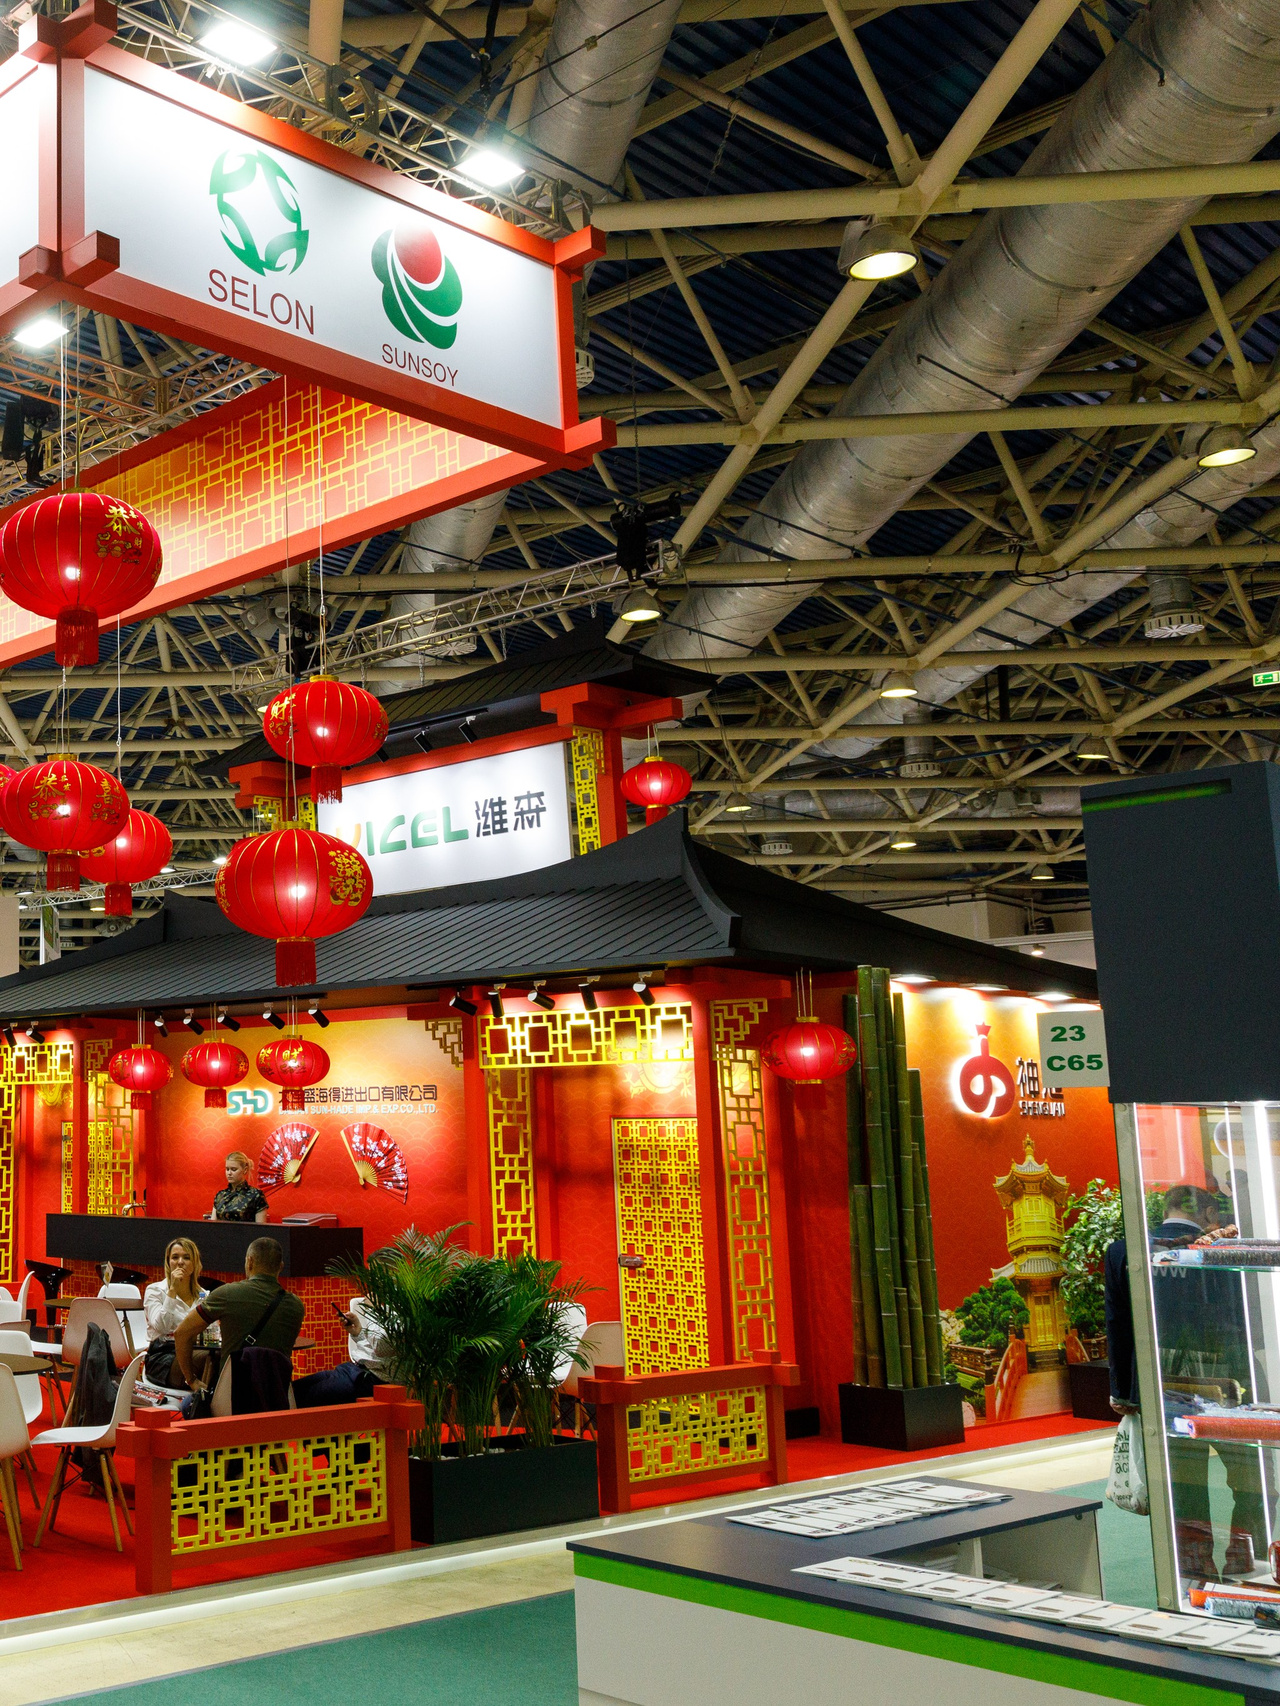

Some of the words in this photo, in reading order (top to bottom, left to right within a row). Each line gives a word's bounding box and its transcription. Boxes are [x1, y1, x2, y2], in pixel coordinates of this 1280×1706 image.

[208, 269, 315, 335] SELON
[381, 343, 458, 386] SUNSOY
[1050, 1025, 1086, 1042] 23
[1046, 1054, 1104, 1072] C65
